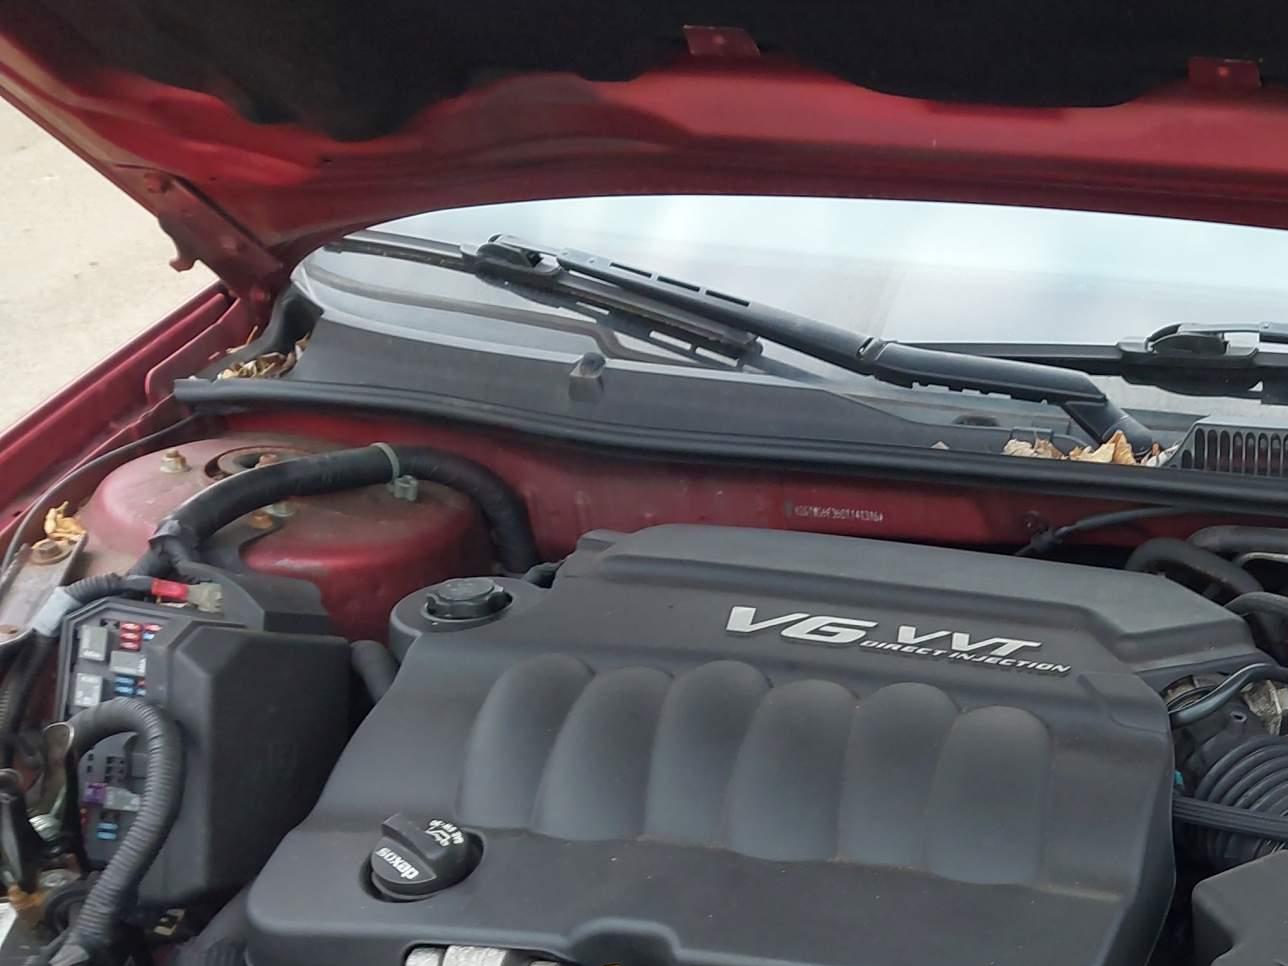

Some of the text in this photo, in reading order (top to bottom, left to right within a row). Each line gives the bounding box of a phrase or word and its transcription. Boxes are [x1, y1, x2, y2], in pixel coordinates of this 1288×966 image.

[726, 606, 1042, 656] V6 VVT
[860, 640, 1071, 673] DIRECT INJECTION
[375, 847, 419, 879] dexos
